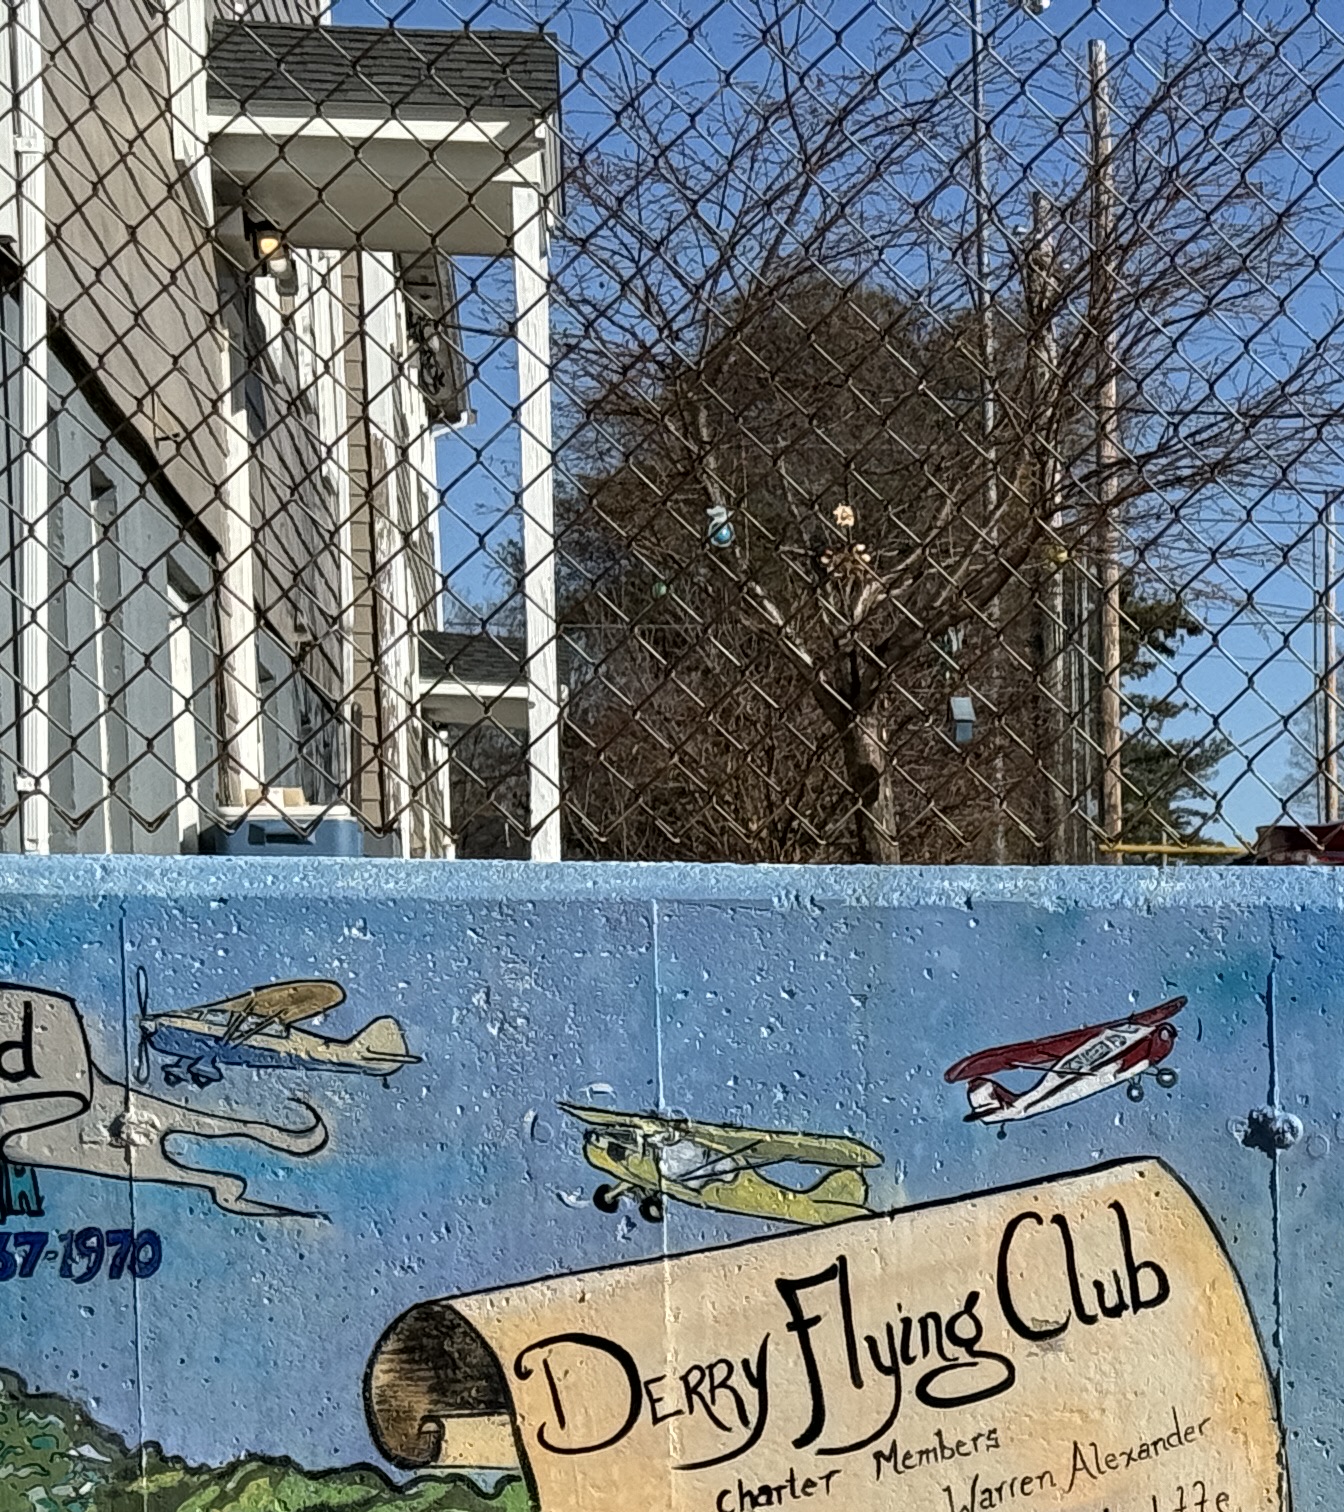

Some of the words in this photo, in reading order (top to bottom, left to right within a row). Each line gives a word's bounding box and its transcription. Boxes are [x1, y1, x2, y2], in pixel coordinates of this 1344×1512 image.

[775, 1254, 1015, 1456] Flying
[1001, 1201, 1170, 1343] Club
[875, 1426, 1001, 1482] Members
[1066, 1406, 1212, 1494] Alexander
